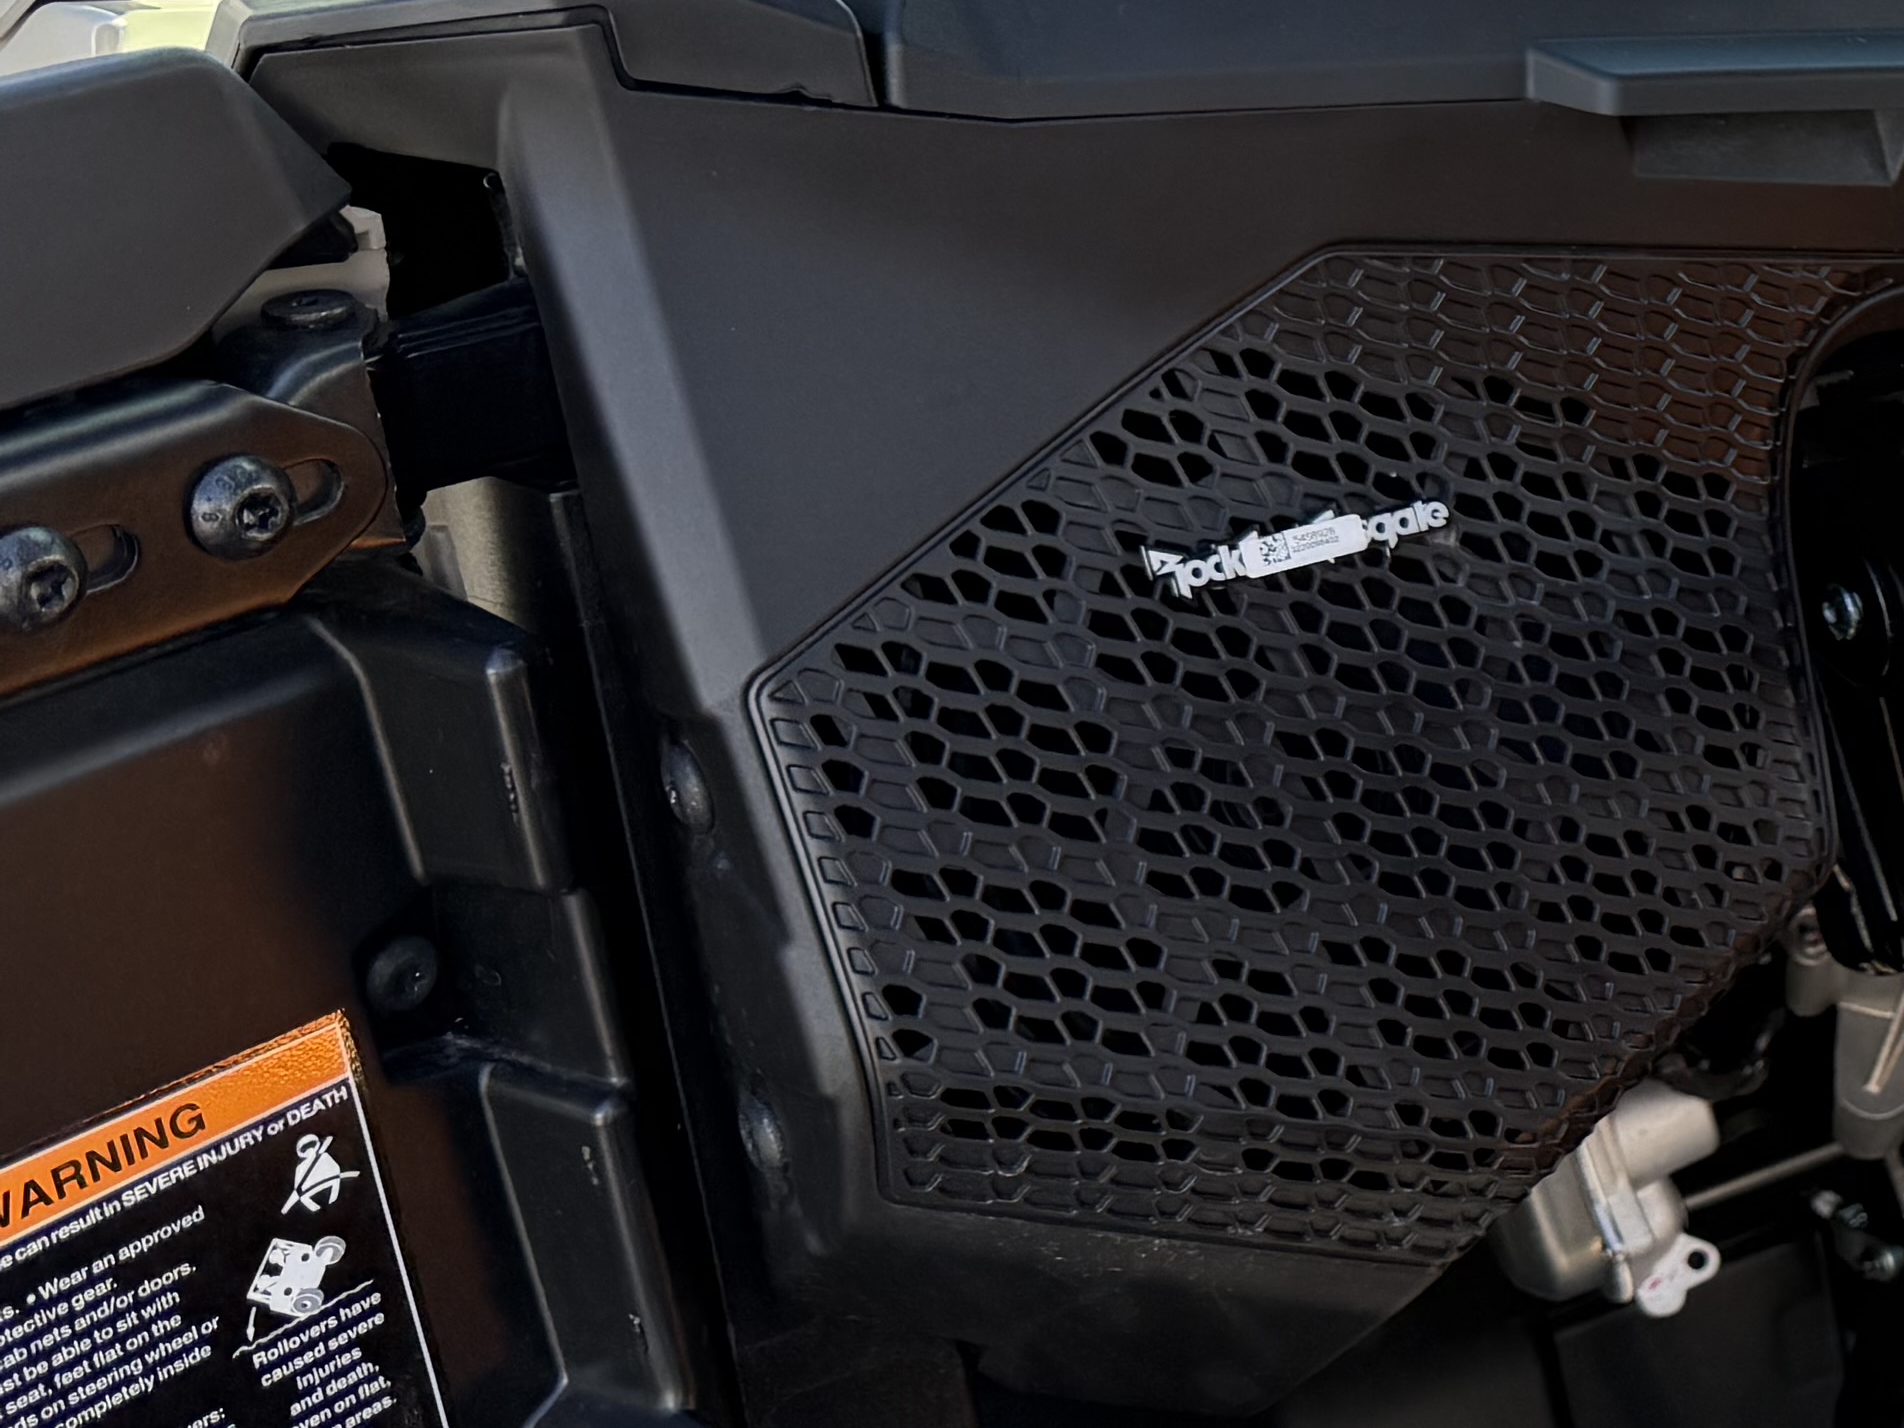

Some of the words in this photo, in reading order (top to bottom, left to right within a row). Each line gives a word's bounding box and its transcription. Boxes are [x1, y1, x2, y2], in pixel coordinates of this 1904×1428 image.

[13, 1234, 50, 1262] can
[49, 1205, 104, 1244] result
[120, 1158, 197, 1207] SEVERE
[195, 1124, 264, 1171] INJURY
[285, 1084, 348, 1126] DEATH
[37, 1265, 88, 1300] Wear
[90, 1252, 116, 1275] an
[117, 1204, 205, 1261] approved
[29, 1323, 72, 1354] nets
[73, 1289, 135, 1331] and/or
[136, 1262, 196, 1297] doors.
[70, 1276, 118, 1311] gear.
[251, 1315, 338, 1369] Rollovers
[338, 1291, 381, 1322] have
[4, 1382, 53, 1415] seat,
[52, 1359, 92, 1389] feet
[91, 1341, 124, 1369] flat
[124, 1330, 150, 1351] on
[150, 1313, 182, 1337] the
[21, 1359, 49, 1382] be
[50, 1337, 92, 1367] able
[115, 1310, 140, 1333] sit
[139, 1290, 180, 1320] with
[39, 1398, 66, 1420] on
[67, 1357, 143, 1405] steering
[143, 1324, 199, 1364] wheel
[155, 1344, 212, 1382] inside
[260, 1340, 326, 1387] caused
[326, 1311, 385, 1351] severe
[295, 1346, 362, 1390] injuries
[289, 1385, 324, 1417] and
[324, 1361, 380, 1396] death,
[332, 1393, 357, 1414] on
[356, 1374, 391, 1400] flat,
